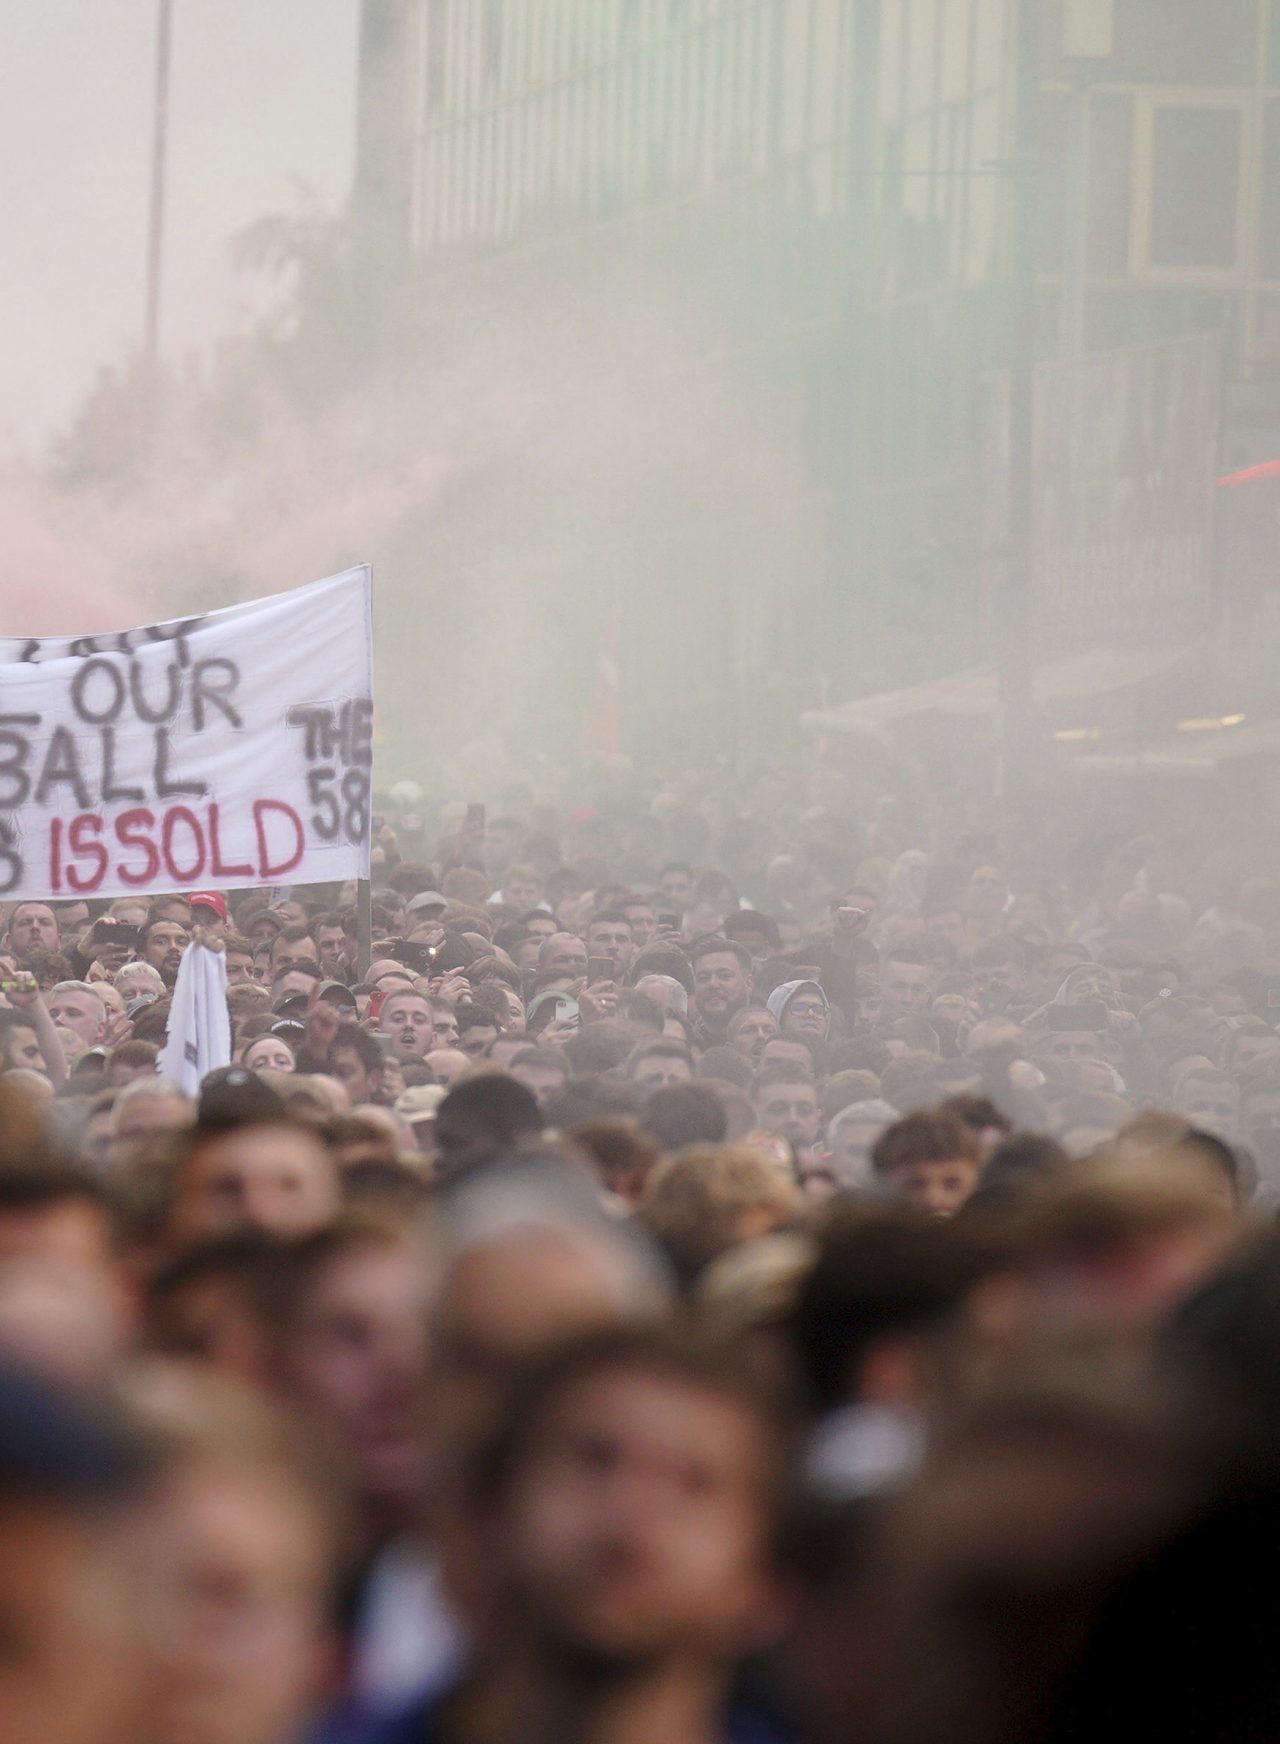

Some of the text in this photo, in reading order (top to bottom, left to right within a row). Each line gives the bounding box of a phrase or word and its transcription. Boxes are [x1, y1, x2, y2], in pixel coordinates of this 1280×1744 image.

[72, 657, 243, 731] OUR
[287, 697, 373, 767] THE
[307, 767, 370, 845] 58
